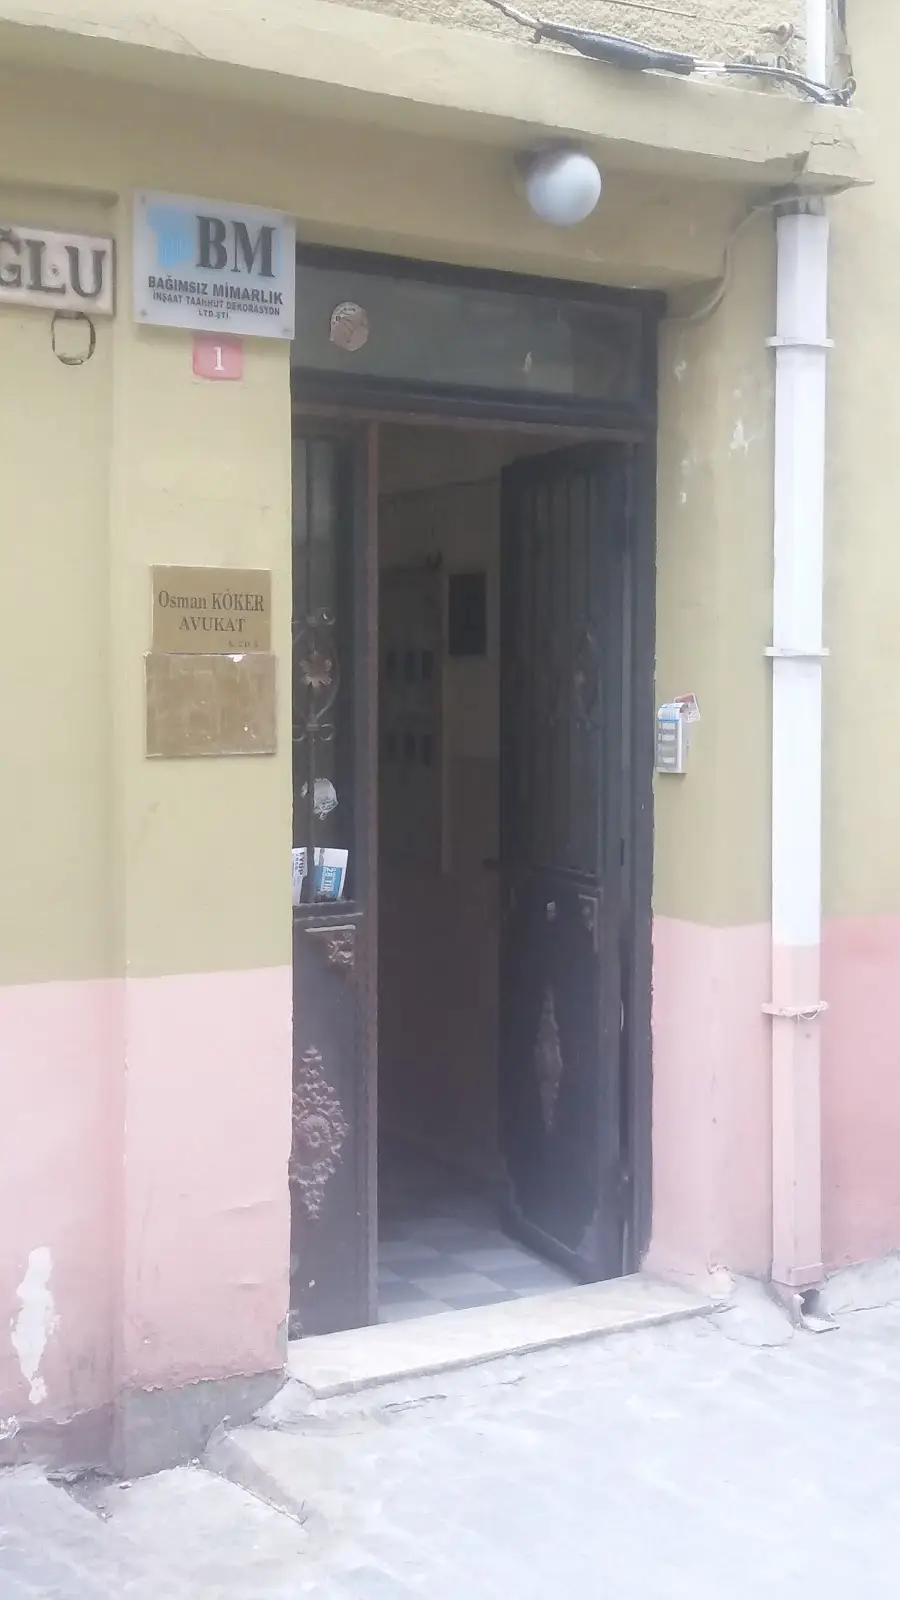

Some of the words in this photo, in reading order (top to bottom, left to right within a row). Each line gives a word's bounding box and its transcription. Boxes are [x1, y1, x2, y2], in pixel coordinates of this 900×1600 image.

[196, 215, 277, 278] BM
[148, 274, 208, 296] BAĞIMSIZ
[212, 282, 284, 305] MİMARLIK
[152, 291, 183, 305] İNŞAAT
[226, 301, 281, 316] DEKORASYON
[214, 346, 225, 371] 1
[158, 590, 207, 609] Osman
[211, 588, 264, 612] KÖKER
[179, 616, 246, 632] AVUKAT
